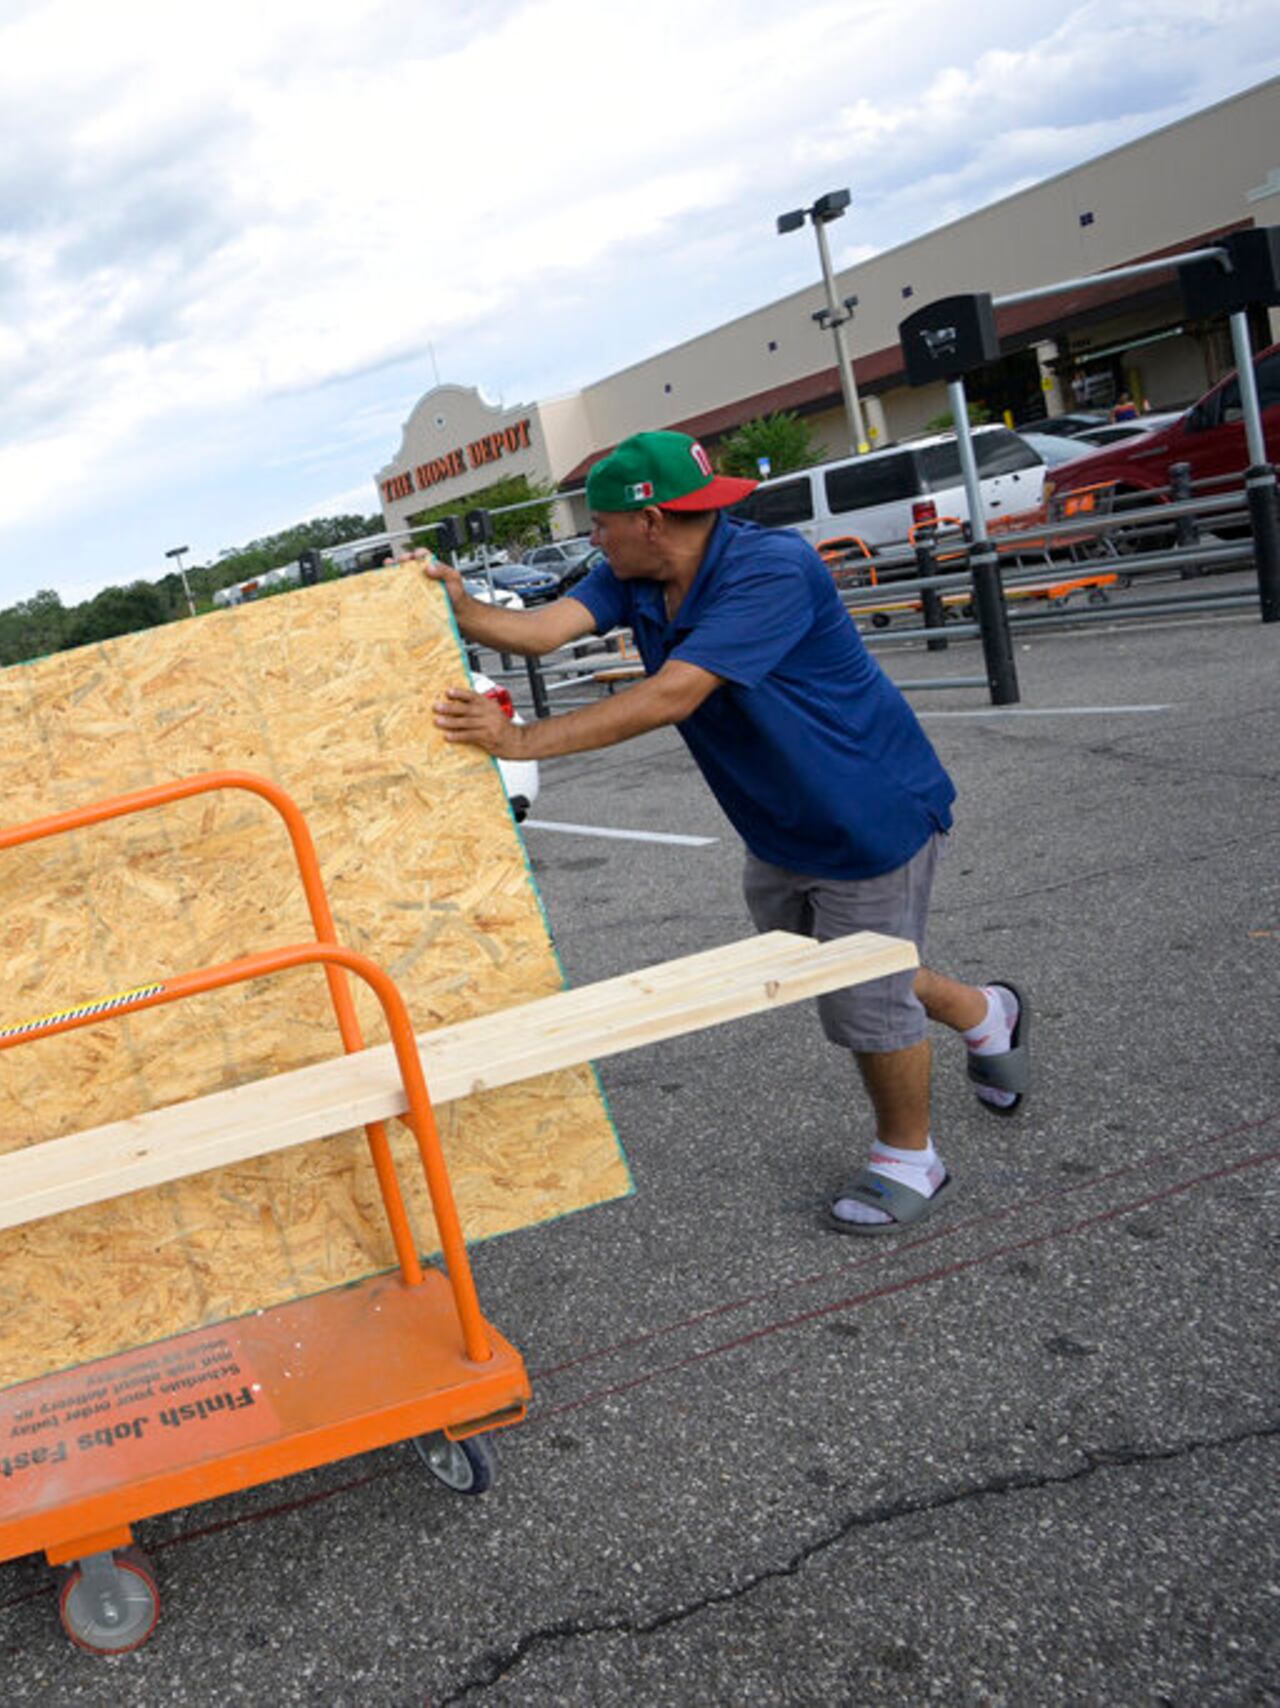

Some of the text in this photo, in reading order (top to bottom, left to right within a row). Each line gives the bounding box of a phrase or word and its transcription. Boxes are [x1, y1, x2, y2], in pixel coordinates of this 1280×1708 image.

[382, 419, 531, 502] THE HOME DEPOT
[160, 1363, 241, 1394] Schedule
[66, 1401, 111, 1421] order
[160, 1387, 257, 1427] Finish
[10, 1415, 59, 1437] today
[77, 1416, 149, 1449] Jobs
